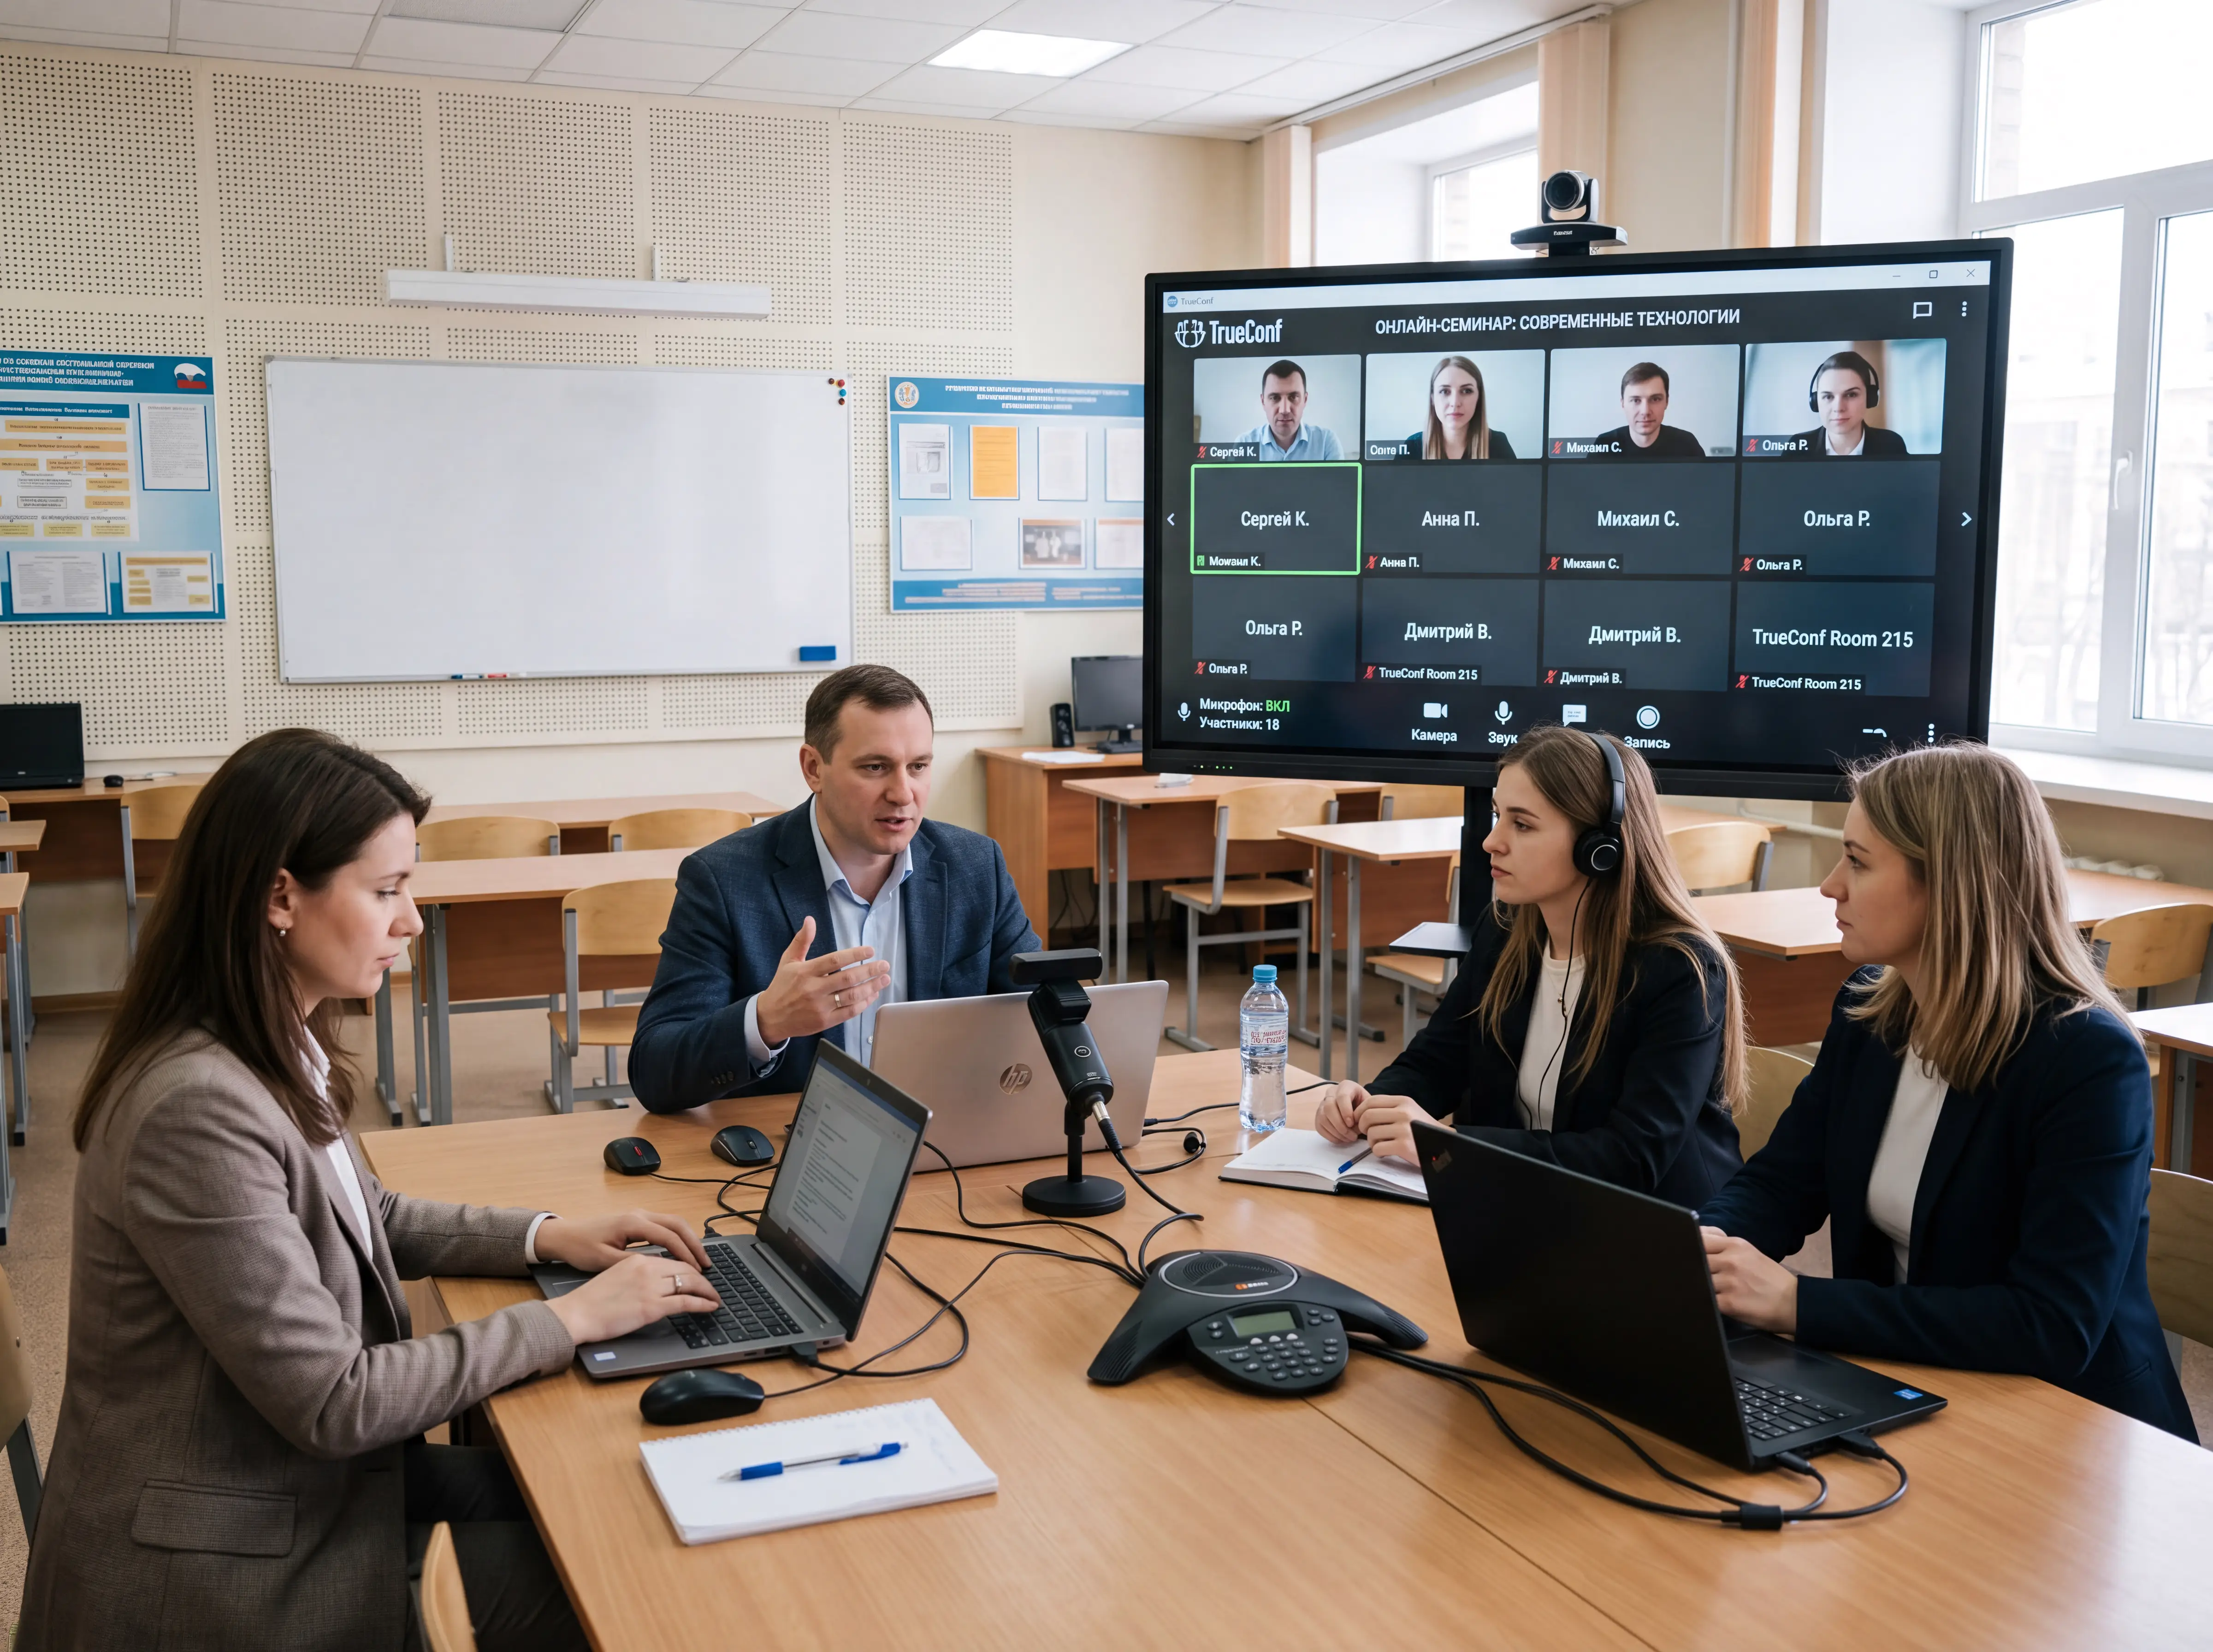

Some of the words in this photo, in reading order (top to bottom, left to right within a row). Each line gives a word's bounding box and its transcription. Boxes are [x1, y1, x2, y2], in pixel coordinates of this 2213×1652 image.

[1375, 316, 1516, 334] ОНЛАЙН-СЕМИНАР:
[1520, 312, 1633, 330] СОВРЕМЕННЫЕ
[1637, 308, 1740, 326] ТЕХНОЛОГИИ
[1209, 319, 1283, 344] TrueConf
[1399, 444, 1410, 454] П.
[1567, 442, 1609, 453] Михаил
[1611, 442, 1622, 453] С.
[1799, 439, 1808, 450] Р.
[1210, 446, 1244, 459] Сергей
[1247, 446, 1256, 457] К.
[1241, 511, 1291, 530] Сергей
[1296, 511, 1309, 526] К.
[1421, 511, 1460, 526] Анна
[1464, 511, 1479, 526] П.
[1598, 510, 1659, 526] Михаил
[1664, 510, 1680, 526] С.
[1804, 510, 1853, 526] Ольга
[1858, 510, 1870, 526] Р.
[1251, 556, 1261, 566] К.
[1380, 557, 1406, 567] Анна
[1408, 557, 1420, 567] П.
[1563, 558, 1605, 569] Михаил
[1608, 558, 1620, 569] С.
[1793, 559, 1803, 570] Р.
[1246, 620, 1287, 636] Ольга
[1292, 620, 1302, 636] Р.
[1404, 622, 1473, 643] Дмитрий
[1478, 624, 1492, 639] В.
[1588, 625, 1661, 646] Дмитрий
[1666, 627, 1681, 643] В.
[1752, 629, 1827, 646] TrueConf
[1830, 630, 1877, 647] Room
[1882, 631, 1913, 648] 215
[1240, 663, 1248, 674] Р.
[1379, 667, 1425, 678] TrueConf
[1426, 668, 1456, 679] Room
[1458, 669, 1478, 680] 215
[1560, 672, 1609, 685] Дмитрий
[1612, 673, 1622, 684] В.
[1751, 677, 1803, 688] TrueConf
[1805, 678, 1837, 689] Room
[1840, 679, 1861, 690] 215
[1200, 698, 1263, 714] Микрофон:
[1266, 700, 1290, 712] ВКЛ
[1199, 716, 1263, 730] Участники:
[1266, 718, 1279, 731] 18
[1412, 728, 1457, 743] Камера
[1488, 732, 1518, 747] Звук
[1624, 736, 1670, 750] Запись
